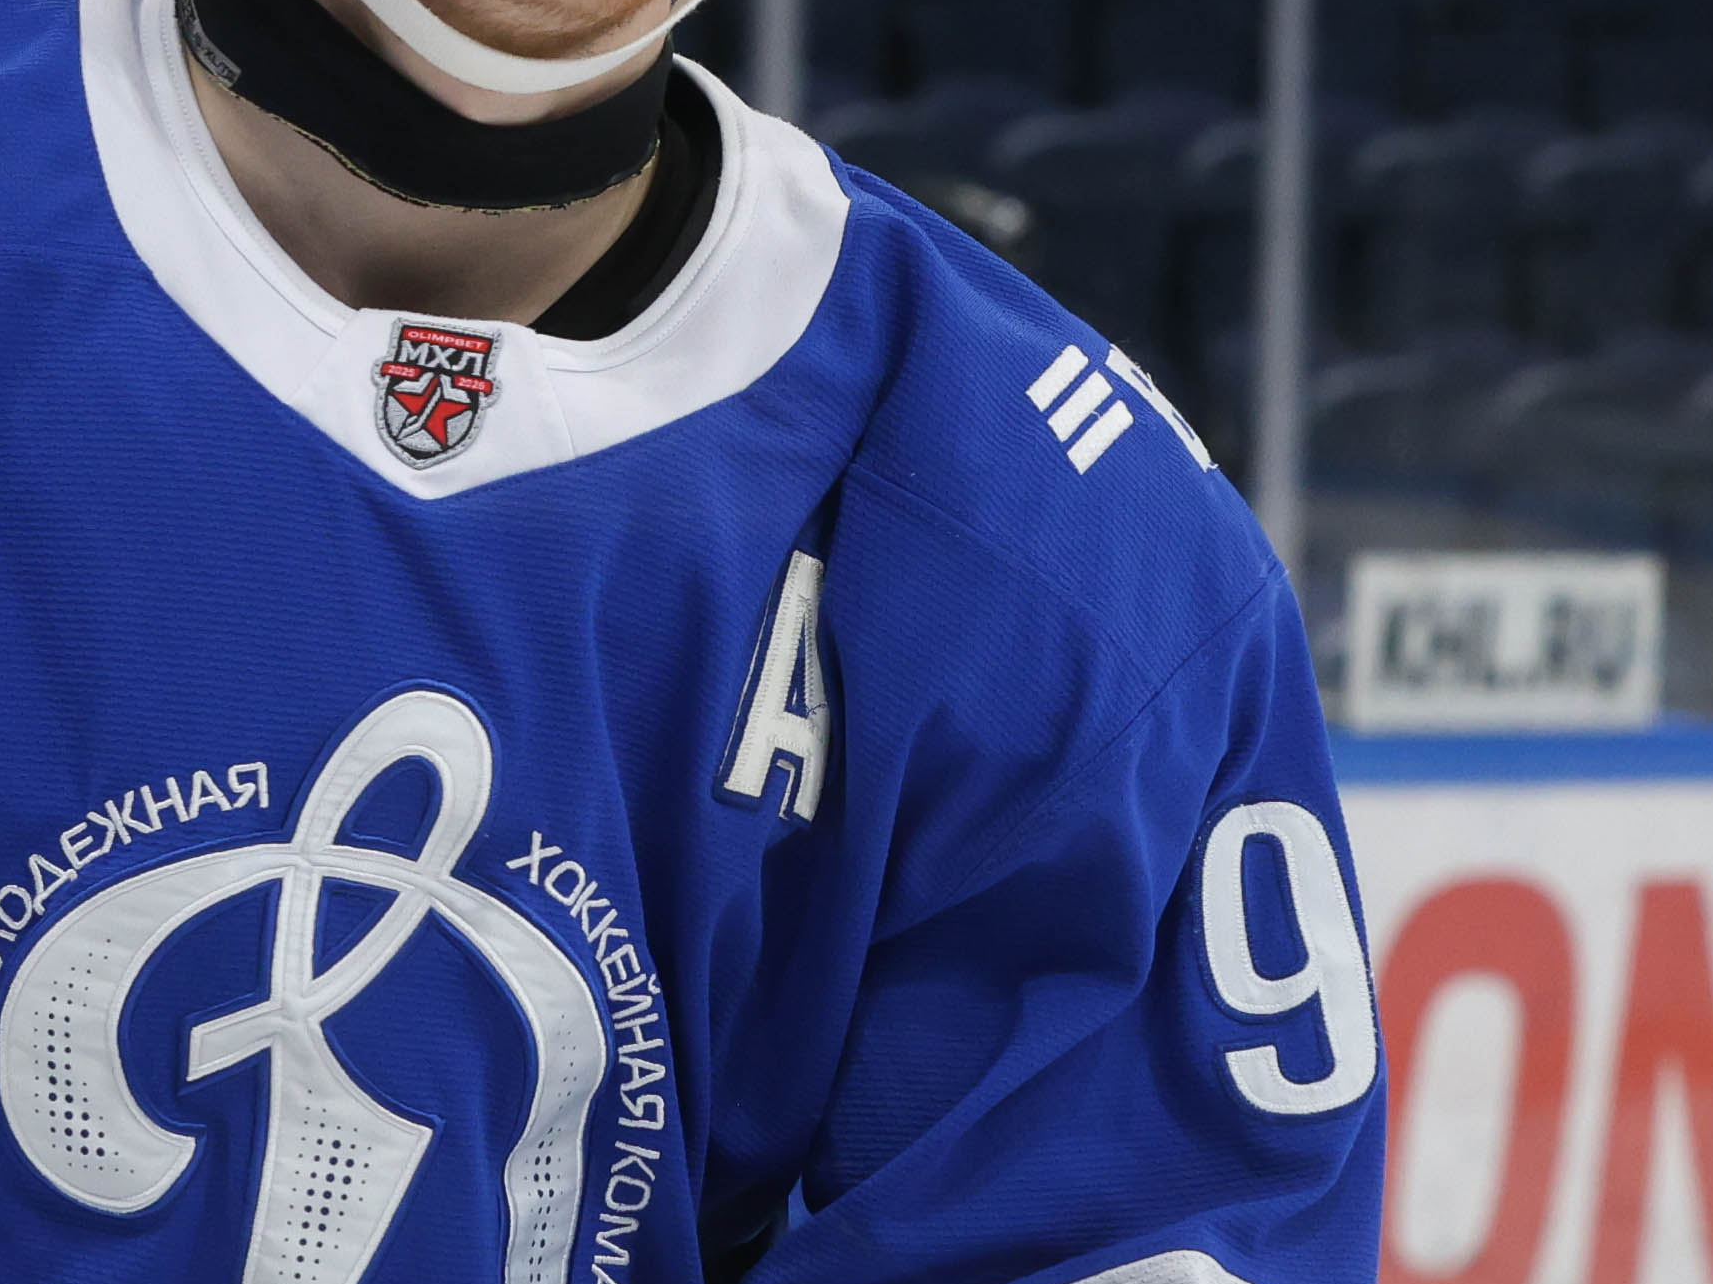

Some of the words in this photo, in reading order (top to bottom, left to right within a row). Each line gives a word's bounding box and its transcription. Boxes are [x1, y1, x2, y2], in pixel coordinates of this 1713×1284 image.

[398, 339, 486, 376] МХЛ
[407, 330, 486, 350] OLIMPBET
[505, 829, 666, 1131] ХОККЕЙНАЯ
[1201, 800, 1378, 1115] 9
